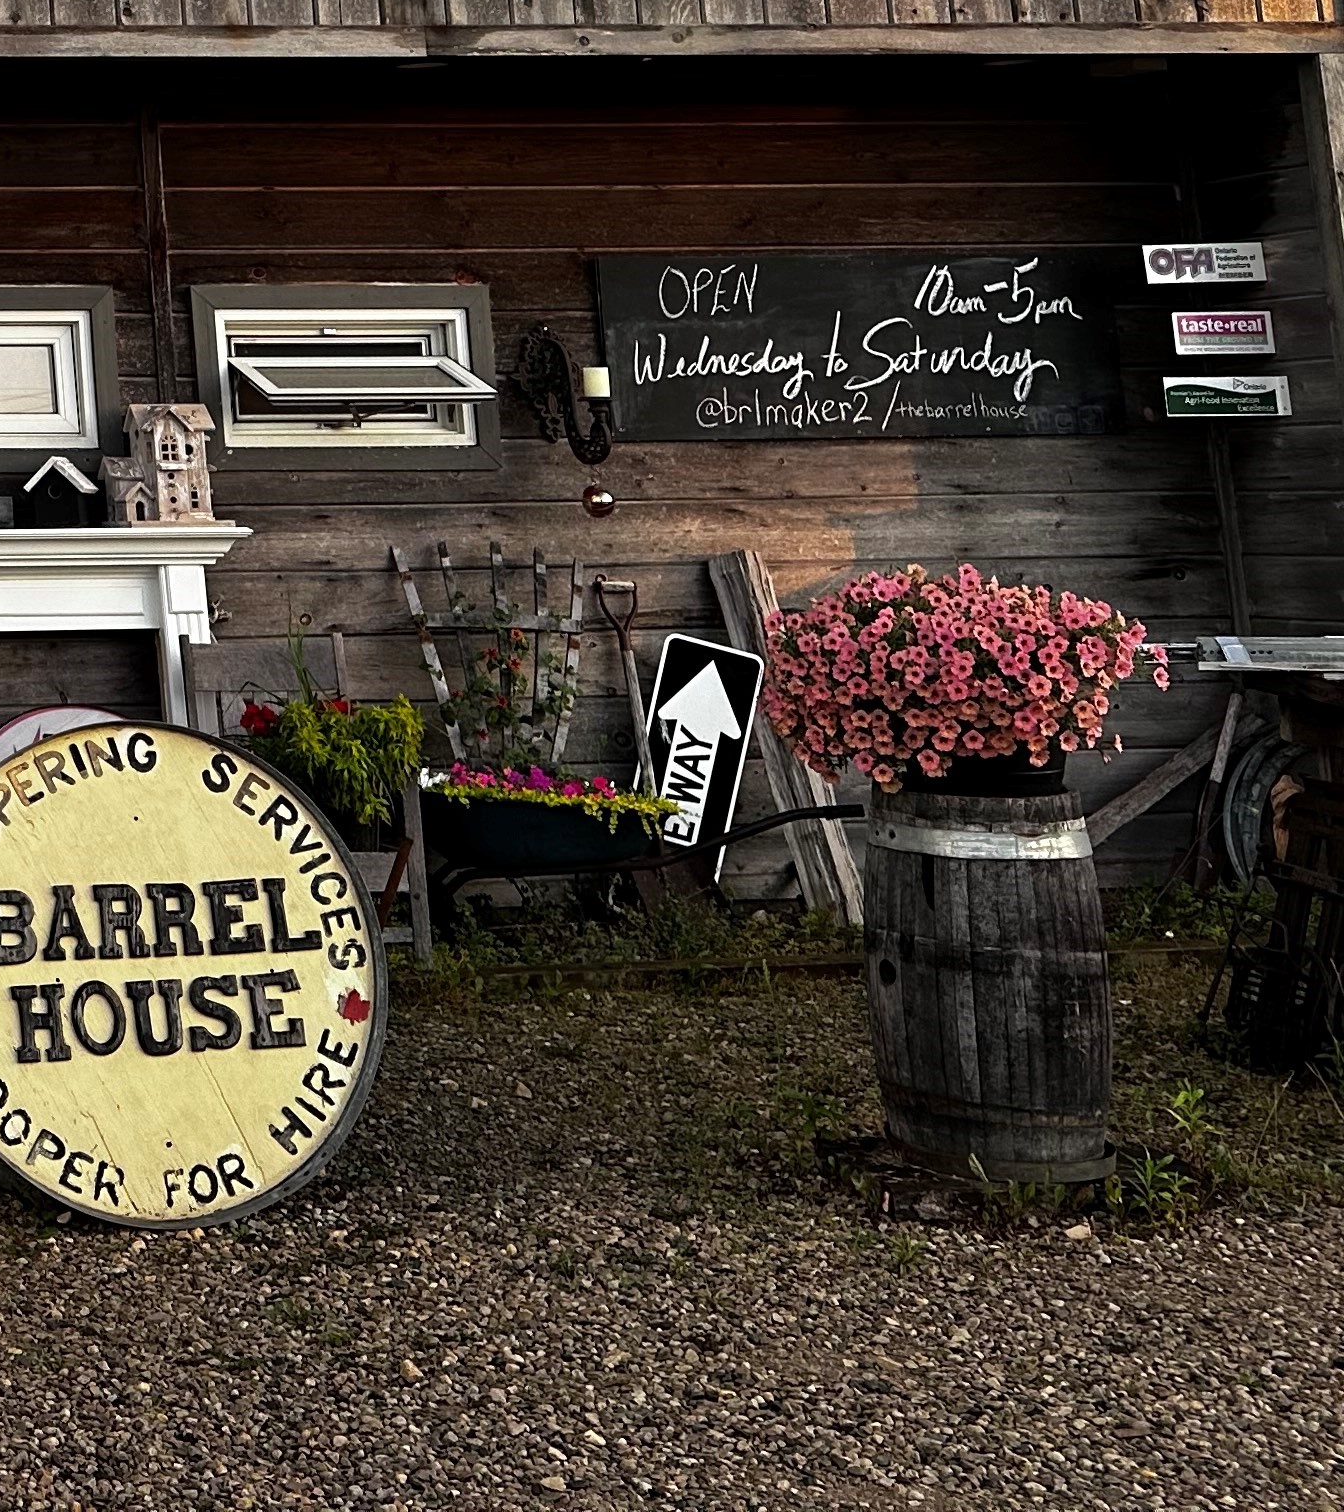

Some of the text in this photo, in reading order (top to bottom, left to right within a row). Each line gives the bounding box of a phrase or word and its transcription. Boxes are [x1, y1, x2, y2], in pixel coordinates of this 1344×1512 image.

[658, 264, 758, 319] OPEN
[1149, 248, 1216, 280] OFA
[634, 310, 1060, 402] Wednesday to Saturday
[665, 724, 714, 804] WAY
[201, 752, 367, 970] SERVICES
[10, 967, 307, 1064] HOUSE
[162, 1153, 255, 1208] FOR
[267, 1028, 360, 1155] HIRE
